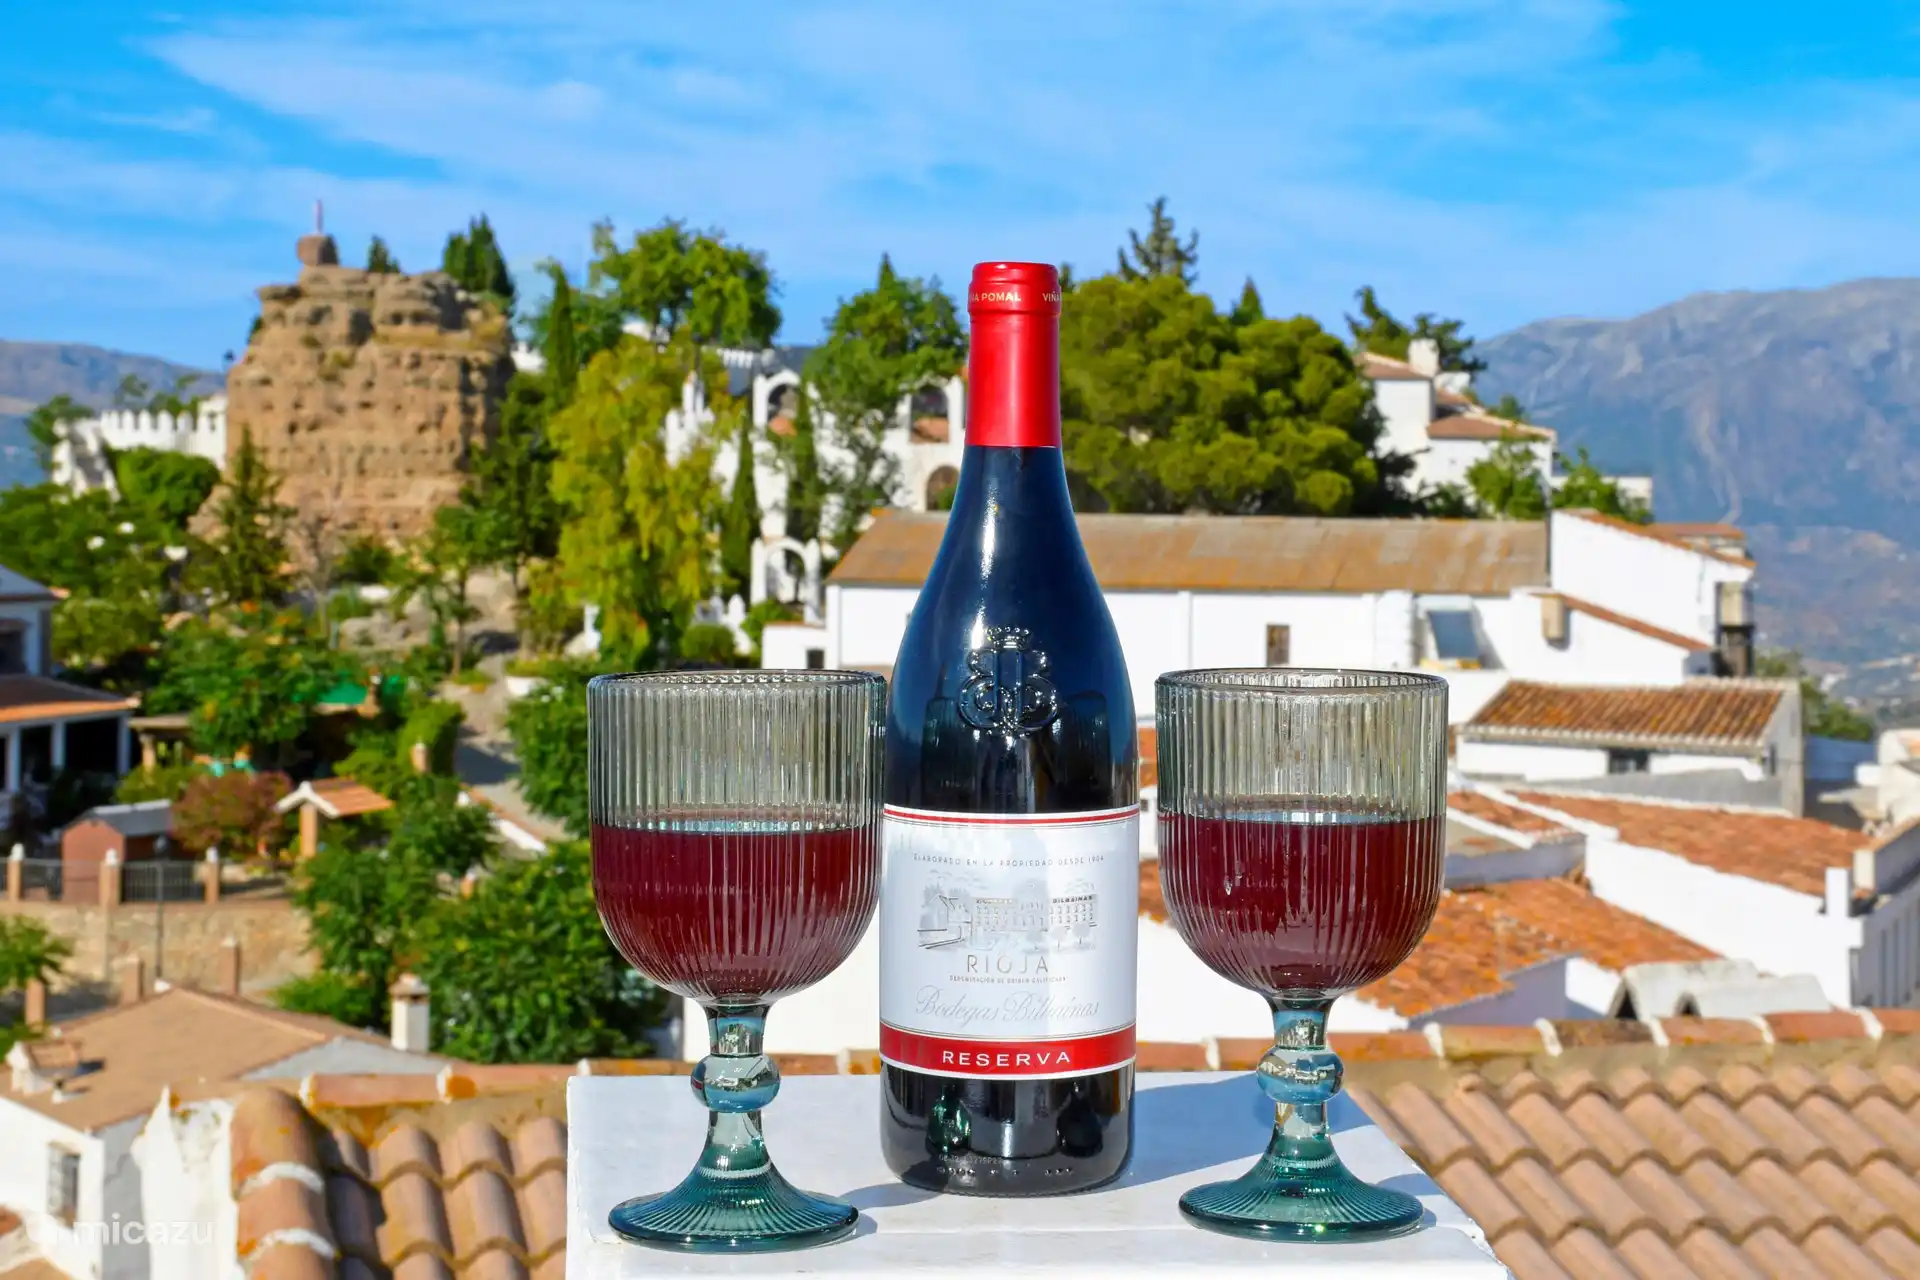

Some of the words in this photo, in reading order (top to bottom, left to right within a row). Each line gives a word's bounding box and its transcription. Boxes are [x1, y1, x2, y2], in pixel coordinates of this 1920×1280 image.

[981, 291, 1022, 302] POMAL
[913, 853, 961, 865] ELABORADO
[966, 859, 978, 867] EN
[1000, 859, 1053, 867] PROPIEDAD
[1058, 858, 1084, 866] DESDE
[966, 954, 1049, 974] RIOJA
[915, 984, 999, 1029] Bodegas
[942, 1050, 1071, 1068] RESERVA
